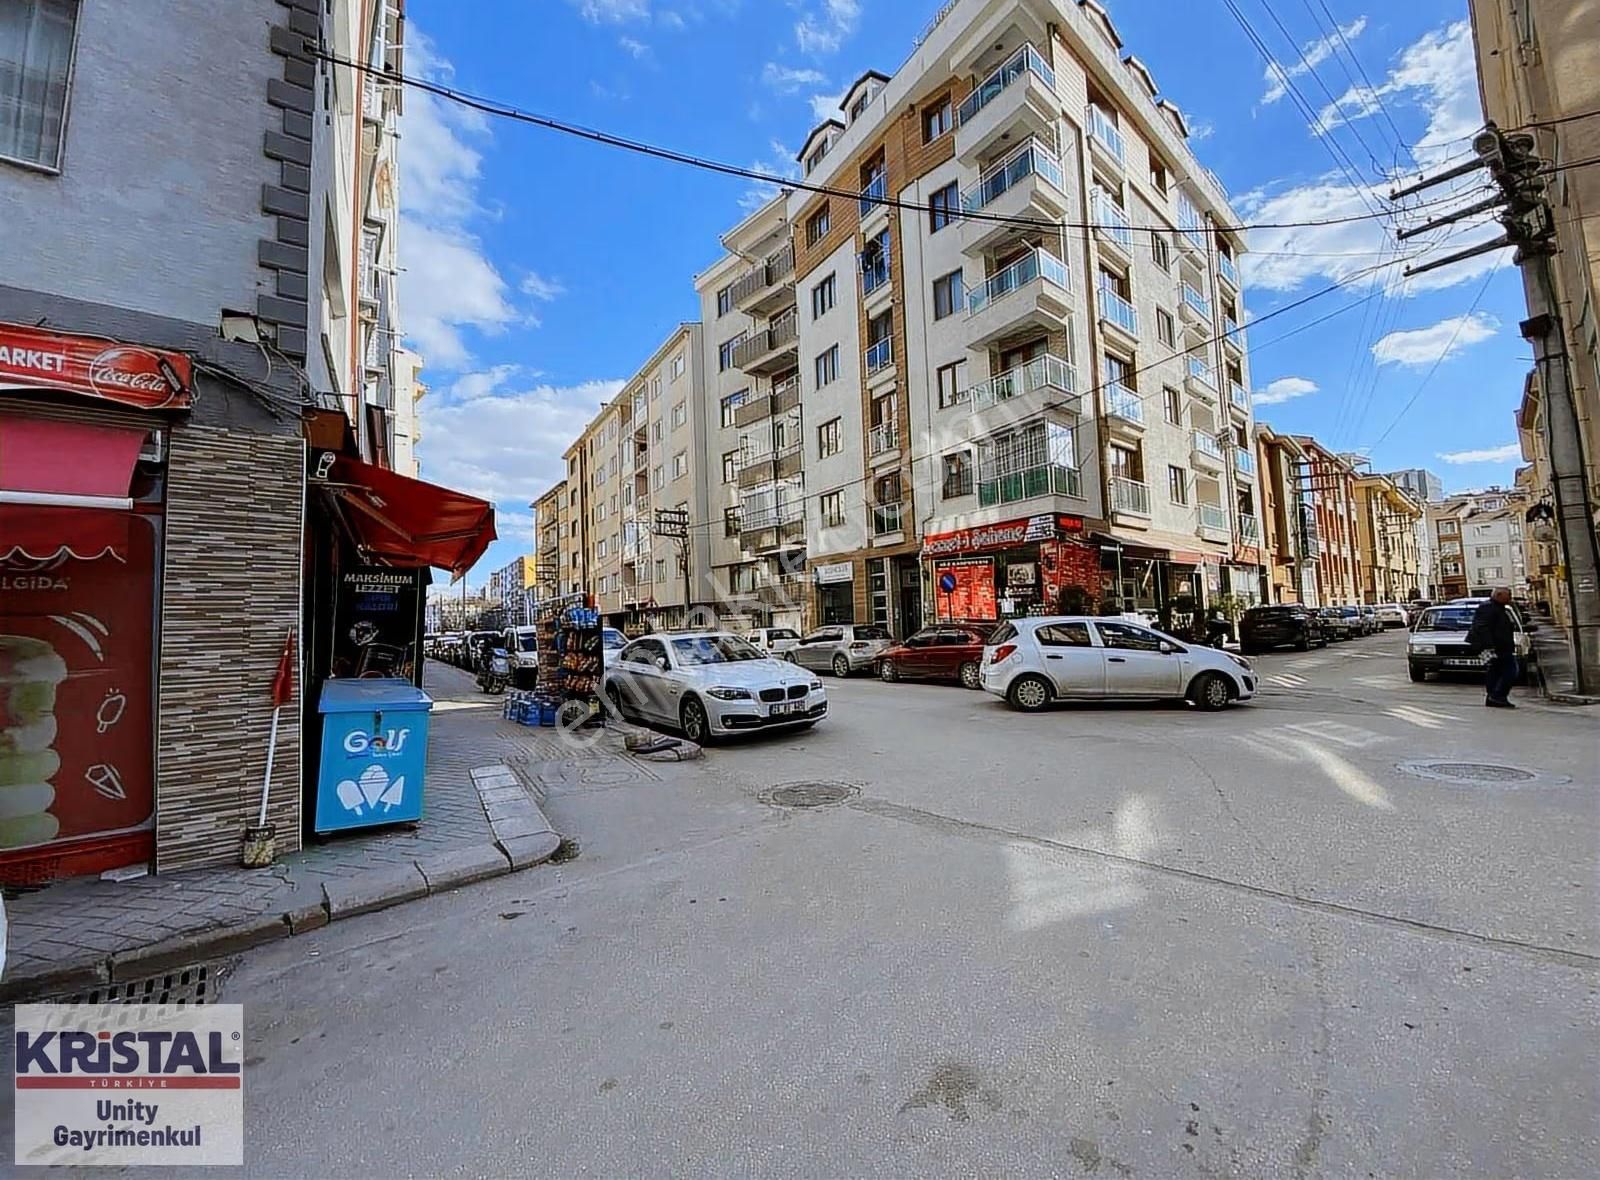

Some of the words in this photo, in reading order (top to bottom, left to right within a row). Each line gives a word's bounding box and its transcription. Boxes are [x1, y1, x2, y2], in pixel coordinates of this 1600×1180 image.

[95, 367, 167, 392] Coca-Cola
[355, 583, 401, 594] LEZZET
[343, 728, 411, 753] Golf
